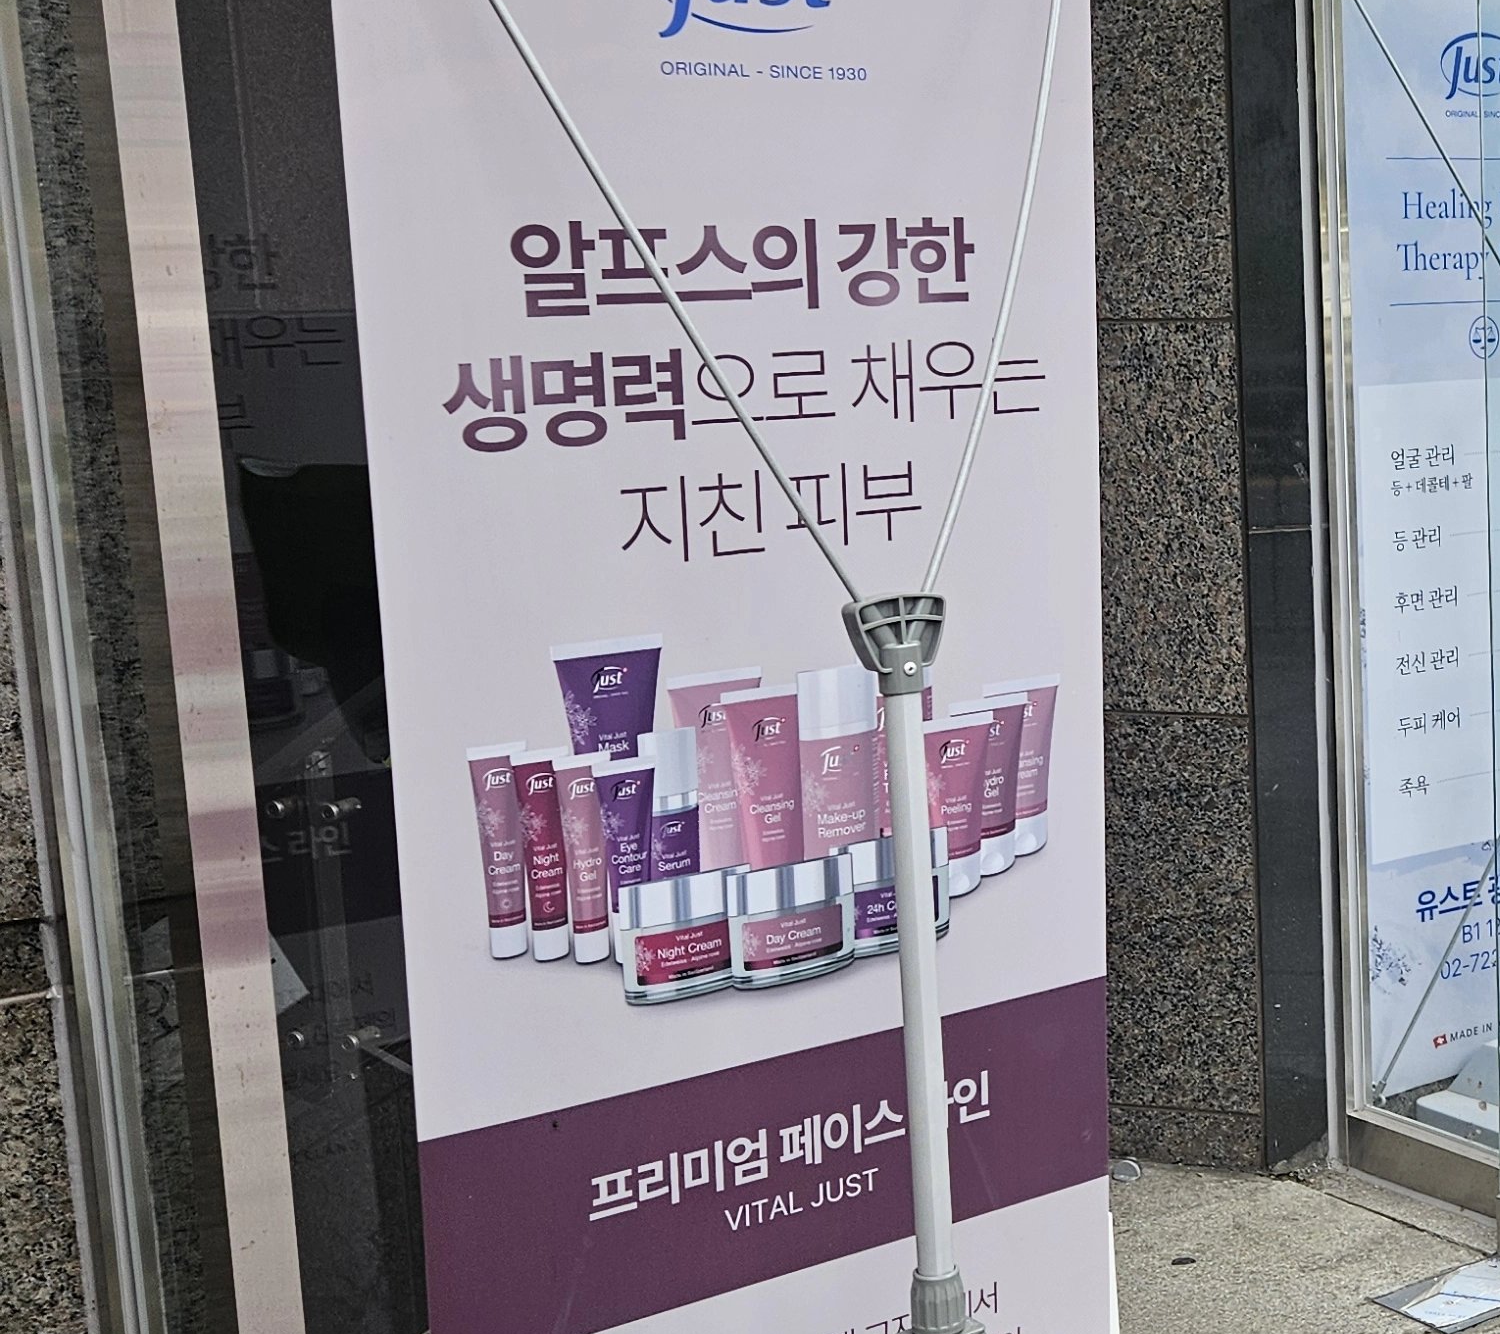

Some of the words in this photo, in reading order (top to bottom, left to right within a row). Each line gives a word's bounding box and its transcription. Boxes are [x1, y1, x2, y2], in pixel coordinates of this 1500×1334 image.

[660, 60, 750, 78] ORIGINAL
[769, 64, 823, 80] SINCE
[828, 67, 868, 81] 1930
[1402, 187, 1492, 229] Healing
[509, 218, 820, 318] 알프스의
[836, 216, 975, 308] 강한
[1396, 240, 1490, 280] Therapy
[442, 347, 837, 453] 생명력으로
[850, 337, 1046, 423] 채우는
[1390, 447, 1422, 471] 얼굴
[1425, 443, 1455, 467] 관리
[1390, 480, 1404, 497] 등
[1415, 474, 1450, 494] 데콜테
[1461, 472, 1473, 490] 팔
[619, 469, 766, 563] 지친
[785, 460, 923, 546] 피부
[1392, 530, 1409, 552] 등
[1412, 525, 1441, 550] 관리
[1394, 589, 1425, 614] 후면
[1428, 585, 1459, 609] 관리
[1396, 650, 1426, 676] 전신
[1430, 645, 1460, 671] 관리
[1397, 712, 1428, 738] 두피
[1431, 706, 1461, 731] 케어
[598, 741, 630, 753] Mask
[485, 771, 511, 792] Just
[528, 776, 554, 796] Just
[570, 781, 595, 800] Just
[1398, 774, 1430, 798] 족욕
[697, 788, 738, 803] Cleansin
[984, 786, 1000, 799] Gel
[704, 801, 737, 814] Cream
[750, 798, 795, 815] Cleansing
[817, 808, 866, 825] Make-up
[940, 800, 972, 816] Peeling
[764, 812, 782, 825] Gel
[817, 821, 867, 839] Remover
[493, 851, 515, 862] Day
[611, 850, 648, 865] Contour
[619, 841, 638, 854] Eye
[533, 852, 560, 866] Night
[573, 856, 602, 870] Hydro
[618, 863, 642, 875] Care
[658, 858, 691, 872] Serum
[488, 863, 521, 876] Cream
[531, 866, 563, 880] Cream
[579, 870, 597, 882] Gel
[867, 903, 885, 915] 24h
[1415, 880, 1483, 923] 유스트
[766, 933, 786, 946] Day
[787, 926, 822, 941] Cream
[1462, 922, 1481, 944] B1
[657, 945, 686, 960] Night
[687, 938, 722, 954] Cream
[1450, 1026, 1479, 1042] MADE
[1482, 1022, 1493, 1032] IN
[588, 1127, 769, 1222] 프리미엄
[778, 1099, 906, 1166] 페이스
[723, 1191, 803, 1232] VITAL
[810, 1168, 880, 1208] JUST
